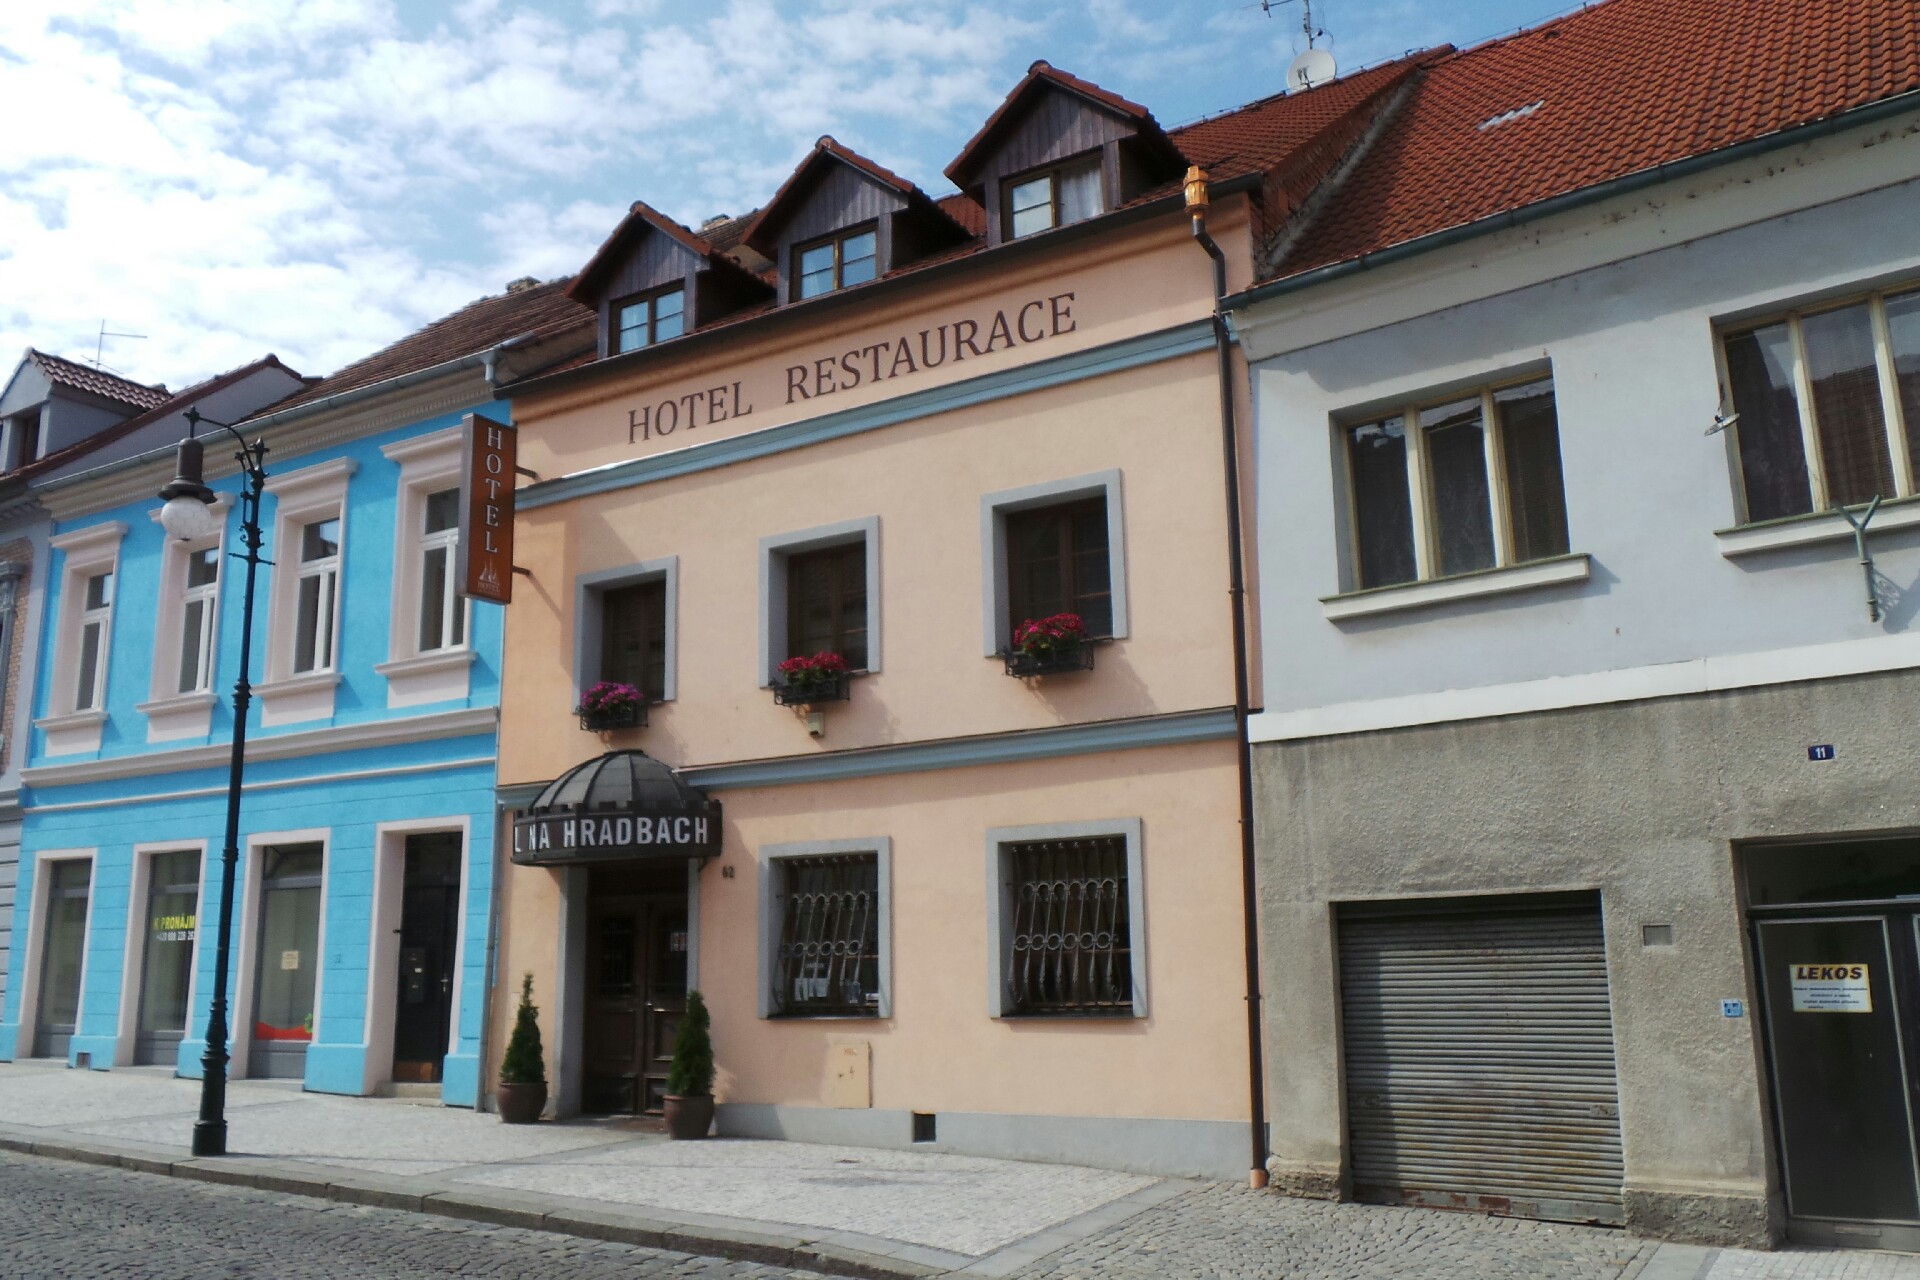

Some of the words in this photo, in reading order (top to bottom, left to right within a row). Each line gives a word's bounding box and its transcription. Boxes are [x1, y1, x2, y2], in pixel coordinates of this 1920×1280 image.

[628, 381, 752, 445] HOTEL
[784, 292, 1077, 404] RESTAURACE
[485, 426, 502, 554] HOTEL
[1815, 746, 1826, 759] 11
[528, 822, 550, 851] NA
[1797, 967, 1862, 980] LEKOS
